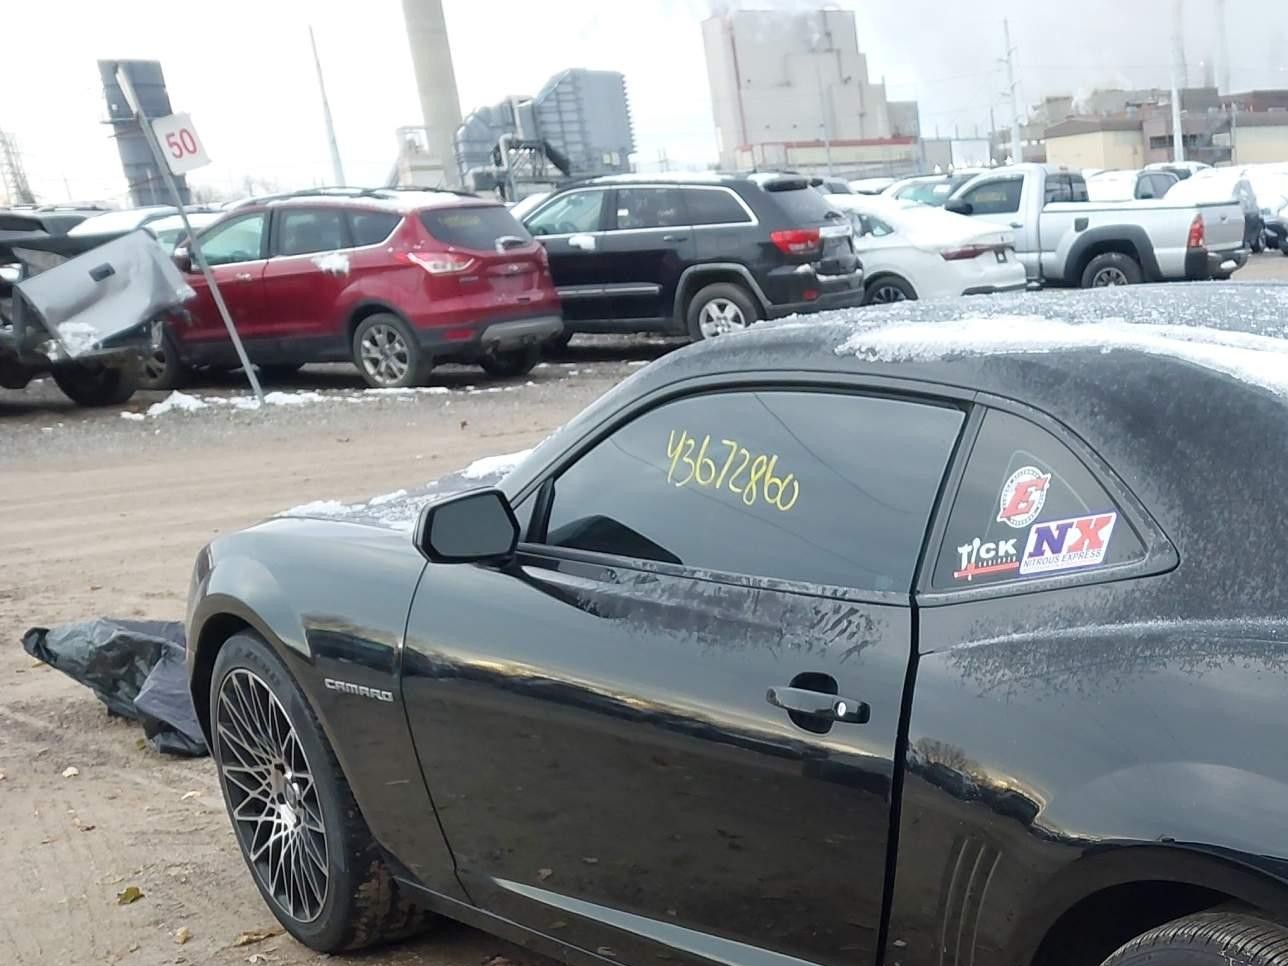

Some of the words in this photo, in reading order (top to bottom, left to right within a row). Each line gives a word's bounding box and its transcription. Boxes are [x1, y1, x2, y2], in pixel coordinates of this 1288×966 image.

[165, 128, 197, 159] 50
[667, 430, 800, 511] 43672860
[1028, 516, 1113, 558] NX
[957, 537, 1017, 571] TICK
[1023, 556, 1060, 568] NITROUS
[1061, 549, 1102, 562] EXPRESS
[324, 677, 394, 702] CAMARO
